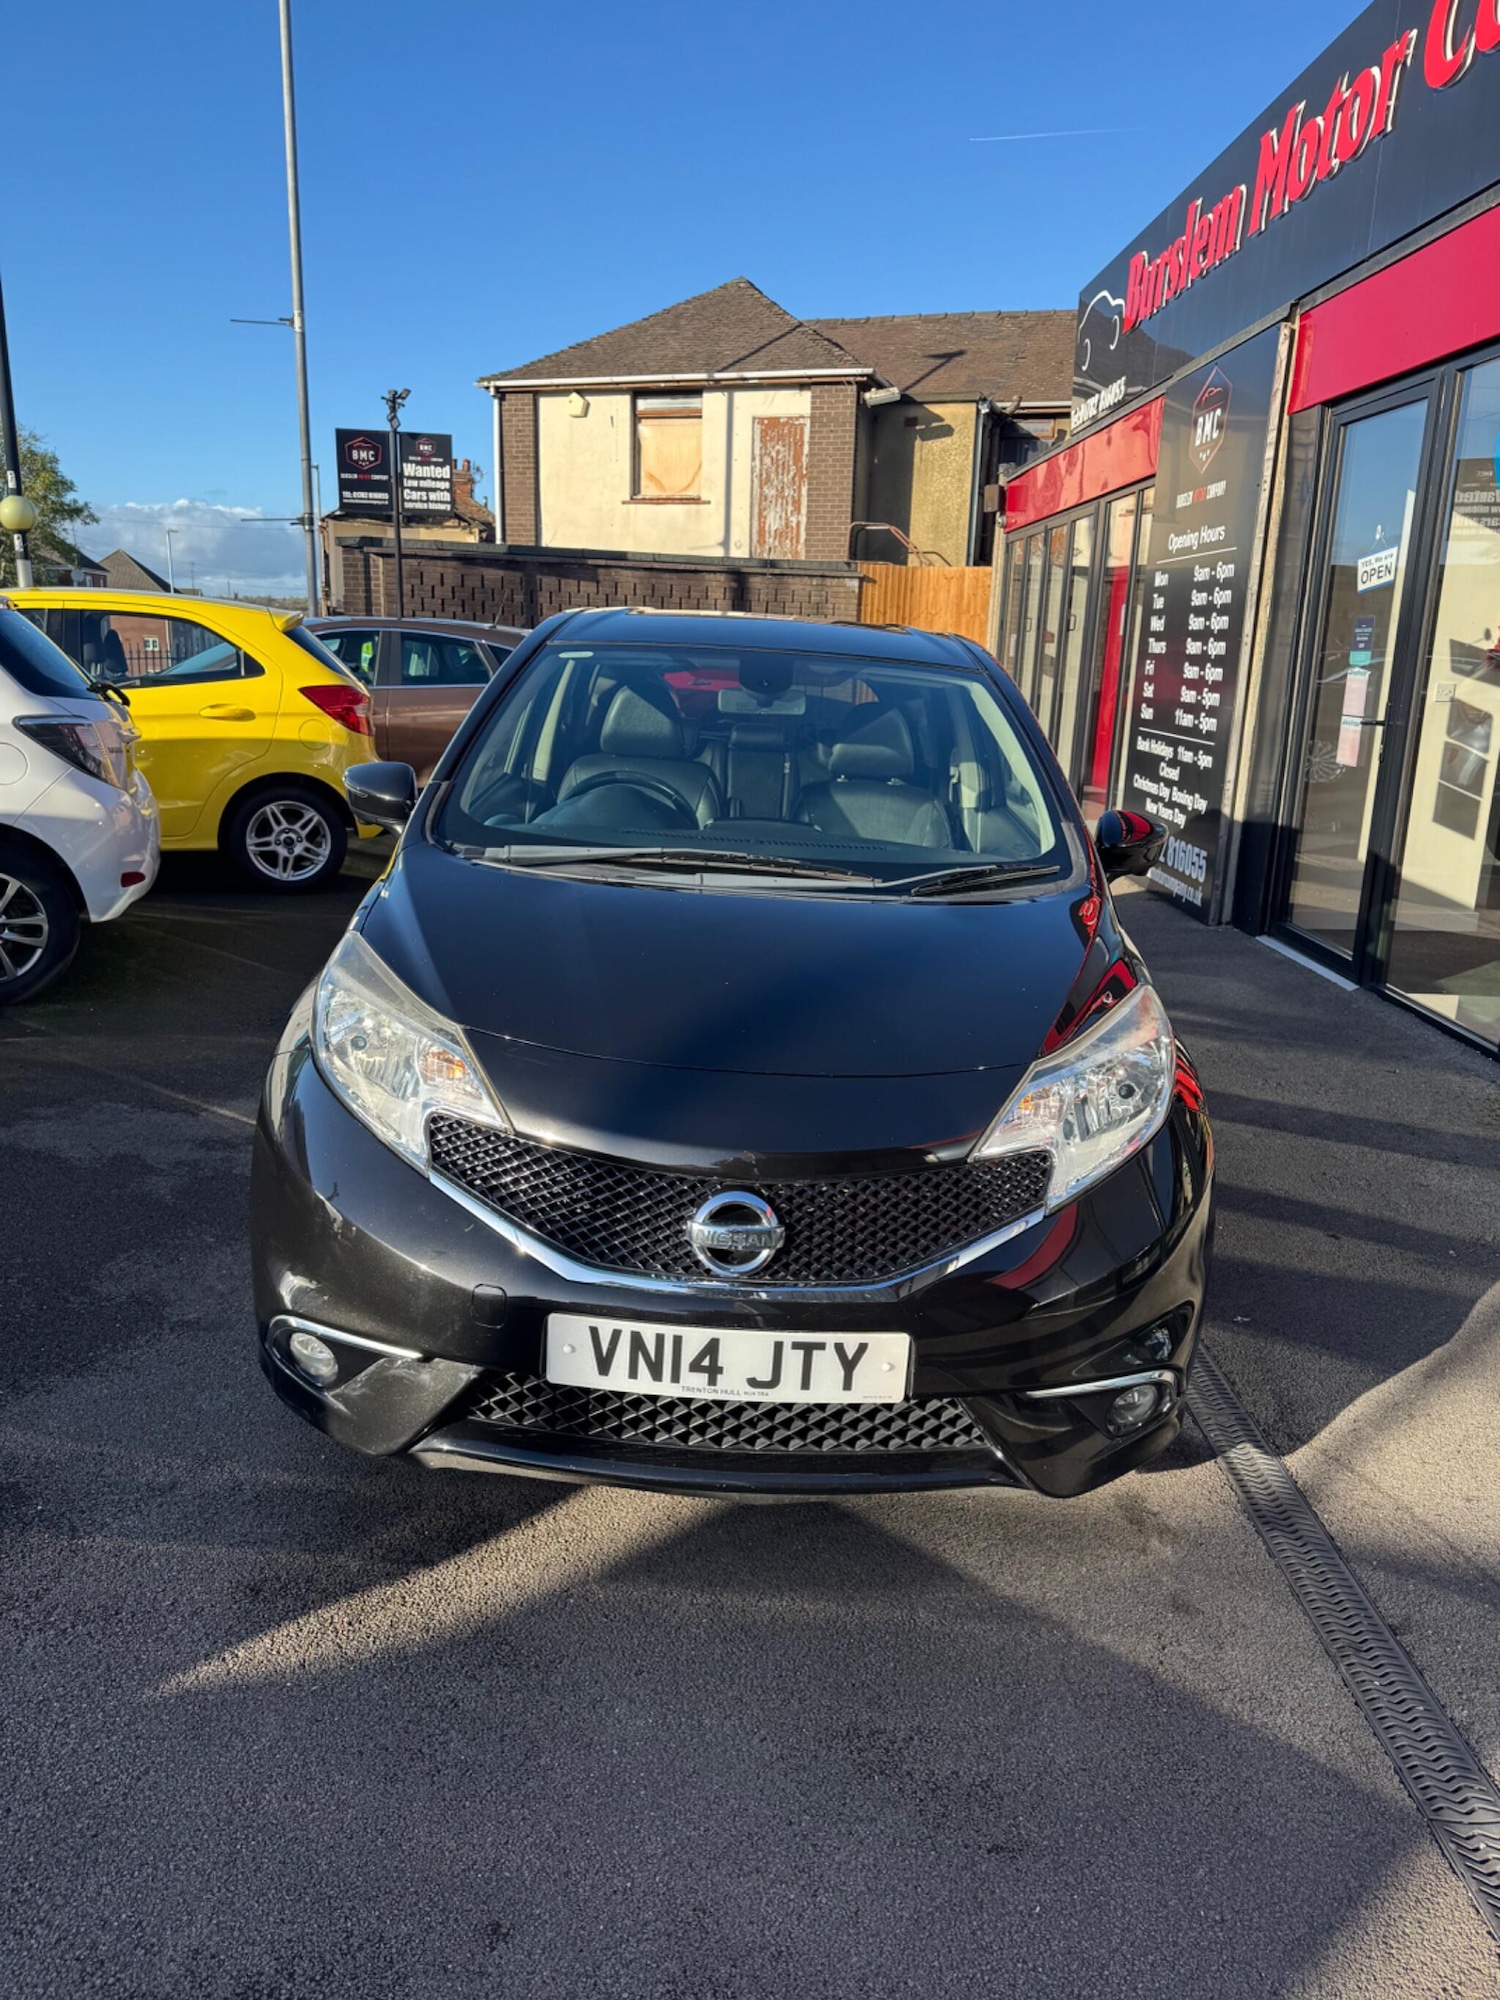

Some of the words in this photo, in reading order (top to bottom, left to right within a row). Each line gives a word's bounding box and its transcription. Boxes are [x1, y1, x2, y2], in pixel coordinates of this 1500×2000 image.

[1123, 184, 1247, 334] Burslem
[1248, 28, 1418, 237] Motor
[1195, 408, 1222, 447] BMC
[352, 449, 375, 461] BMC
[403, 462, 450, 479] Wanted
[403, 478, 418, 487] Low
[419, 479, 450, 489] mileage
[403, 489, 427, 501] Cars
[427, 491, 450, 502] with
[403, 501, 428, 510] service
[428, 503, 451, 512] history
[1168, 529, 1199, 554] Opening
[1200, 525, 1226, 544] Hours
[1154, 570, 1169, 587] Mon
[1193, 564, 1210, 582] 9am
[1216, 561, 1235, 583] 6pm
[1360, 561, 1393, 585] OPEN
[1152, 593, 1164, 609] Tue
[1190, 589, 1208, 607] 9am
[1213, 586, 1232, 609] 6pm
[1150, 615, 1165, 631] Wed
[1188, 612, 1205, 630] 9am
[1211, 611, 1229, 634] 6pm
[1148, 636, 1167, 654] Thurs
[1185, 637, 1202, 655] 9am
[1207, 637, 1226, 659] 6pm
[1144, 659, 1155, 675] Fri
[1182, 661, 1199, 679] 9am
[1205, 662, 1223, 685] 6pm
[1142, 681, 1154, 698] Sat
[1180, 685, 1197, 704] 9am
[1202, 687, 1220, 710] 5pm
[1141, 702, 1154, 720] Sun
[1174, 708, 1194, 728] 11am
[1199, 711, 1217, 734] 5pm
[1136, 735, 1151, 753] Bank
[1151, 739, 1174, 761] Holidays
[1177, 745, 1194, 764] 11am
[1197, 749, 1213, 770] 5pm
[1159, 761, 1180, 781] Closed
[1133, 773, 1160, 795] Christmas
[1159, 782, 1171, 802] Day
[1171, 786, 1194, 811] Boxing
[1194, 793, 1208, 815] Day
[1145, 797, 1158, 815] New
[1158, 801, 1174, 821] Years
[1173, 807, 1187, 829] Day
[1167, 835, 1208, 883] 816055
[695, 1229, 776, 1248] NISSAN
[588, 1325, 724, 1387] VN14
[746, 1340, 869, 1392] JTY
[681, 1385, 719, 1395] TRENTON
[720, 1388, 741, 1397] HULL
